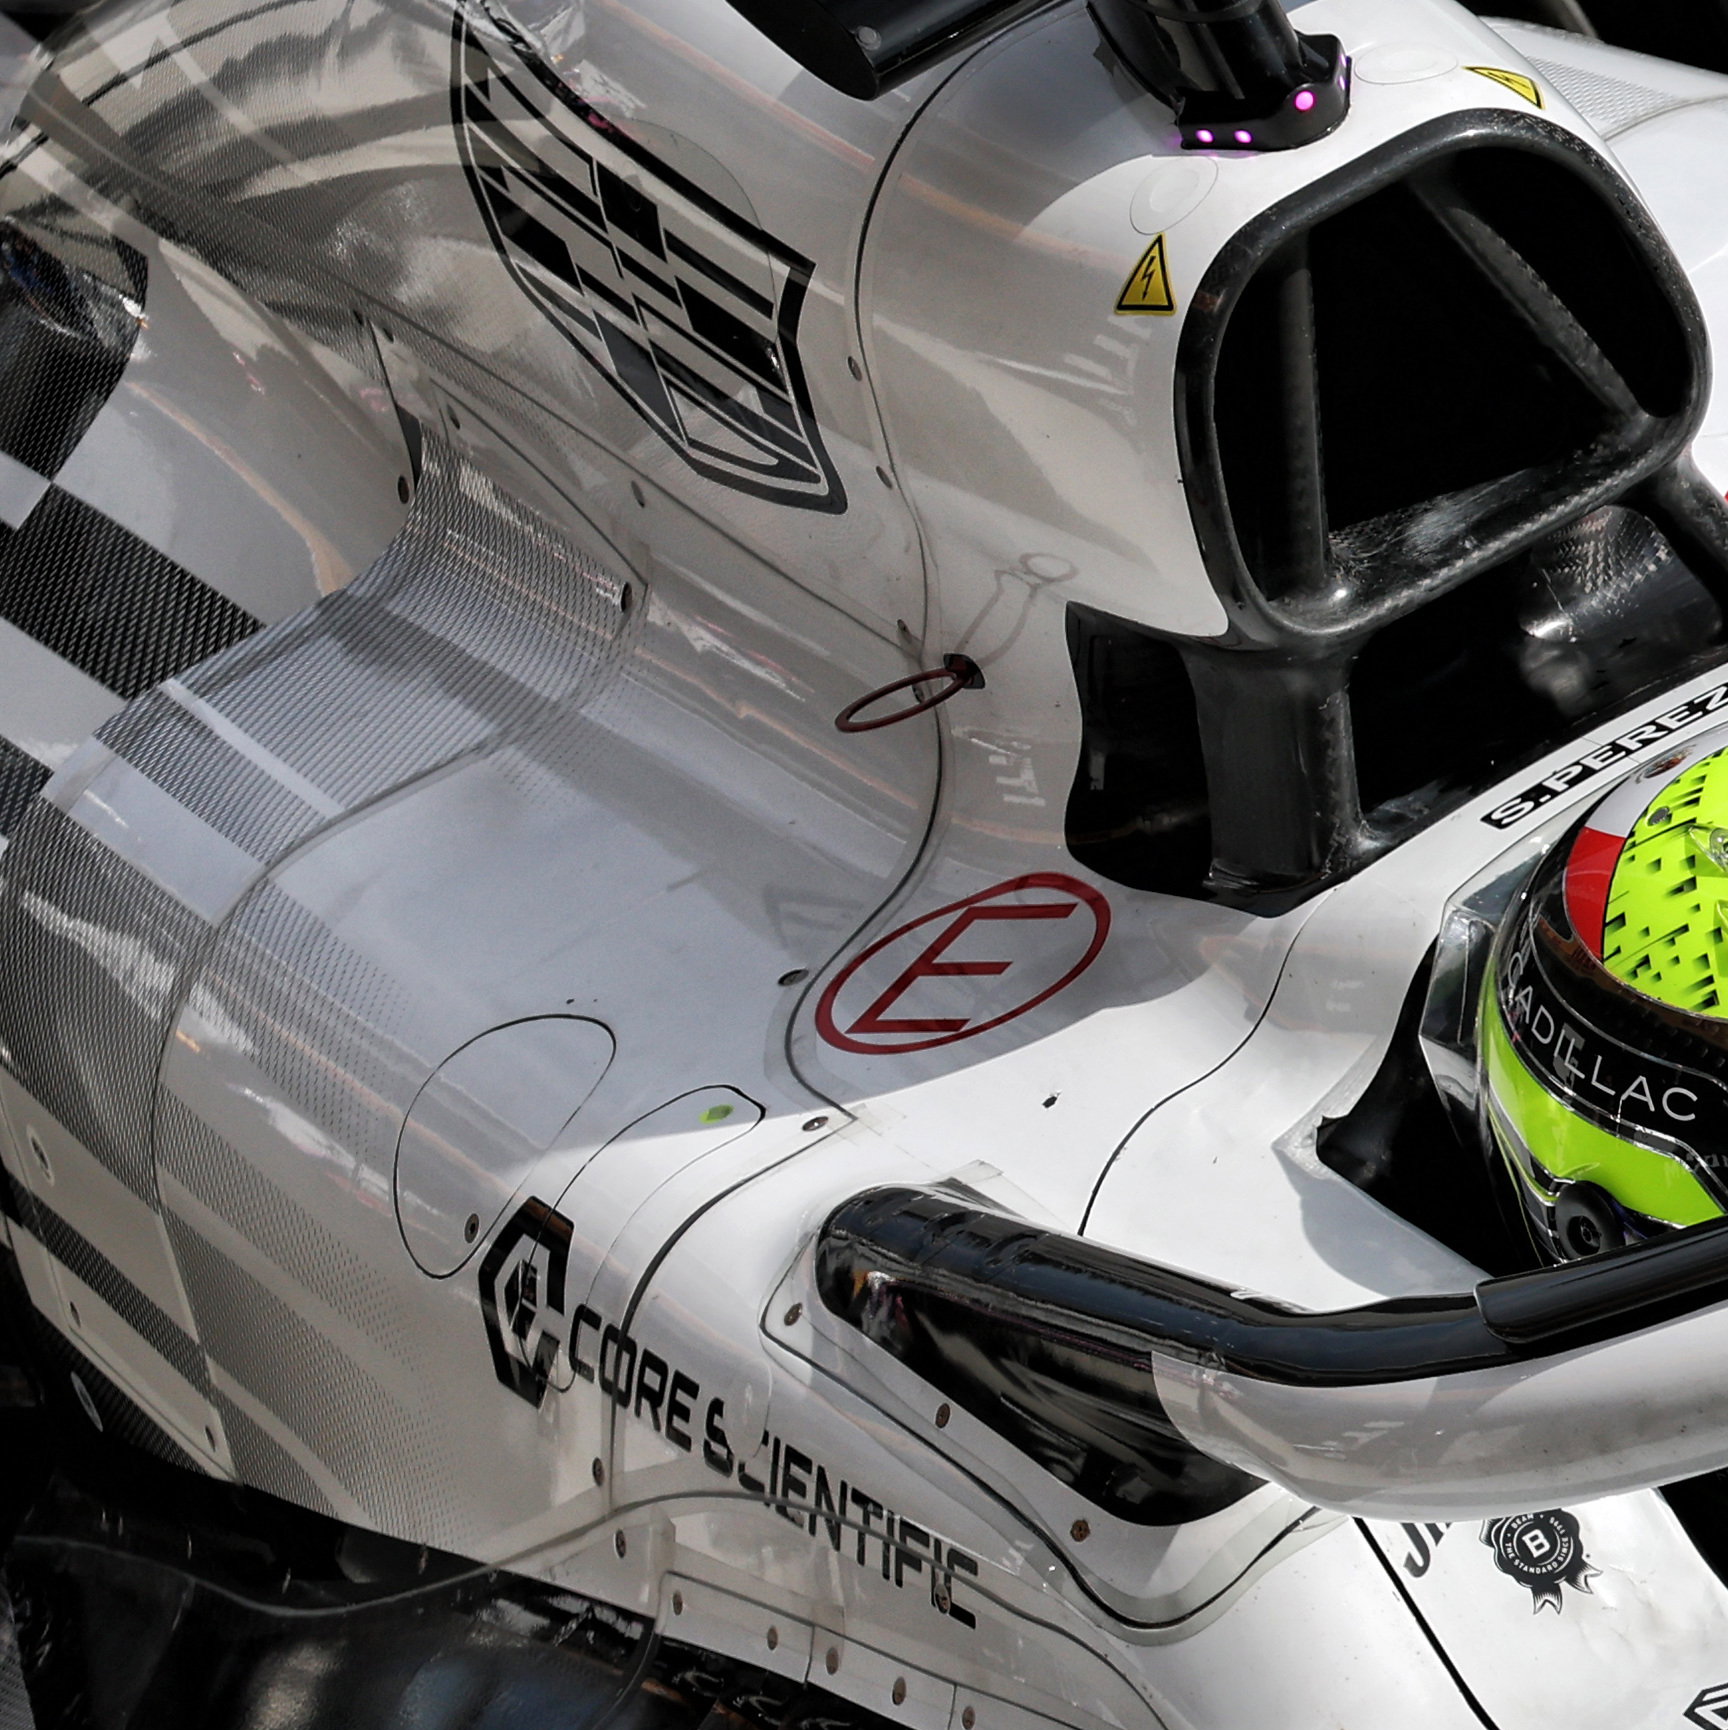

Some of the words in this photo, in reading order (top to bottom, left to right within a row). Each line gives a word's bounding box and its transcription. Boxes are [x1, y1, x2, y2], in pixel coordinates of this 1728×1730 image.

[845, 903, 1078, 1034] E
[1507, 952, 1698, 1121] CADILLAC
[569, 1302, 699, 1453] CORE
[1513, 1559, 1558, 1574] STANDARD
[1521, 1529, 1551, 1558] B
